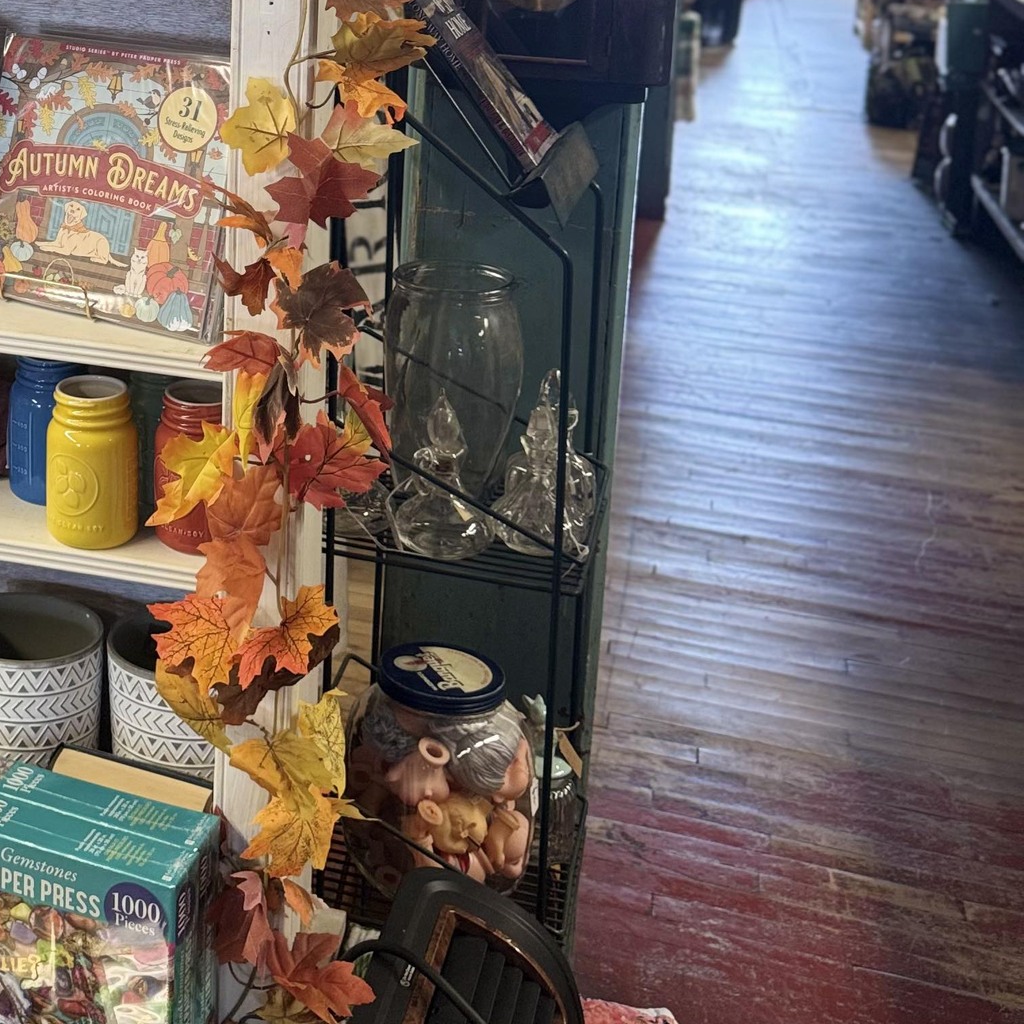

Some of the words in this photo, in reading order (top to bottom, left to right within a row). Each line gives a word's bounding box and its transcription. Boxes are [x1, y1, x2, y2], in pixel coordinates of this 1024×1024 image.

[444, 14, 472, 40] HOME
[178, 96, 203, 122] 31
[164, 116, 206, 139] Stress-Relieving
[172, 130, 194, 144] Designs
[4, 148, 100, 186] AUTUMN
[106, 152, 200, 214] DREAMS
[42, 183, 80, 194] ARTIST'S
[82, 187, 126, 204] COLORING
[128, 197, 152, 212] BOOK
[2, 766, 34, 792] 1000
[0, 843, 78, 882] Gemstones
[40, 879, 102, 918] PRESS
[110, 892, 161, 924] 1000
[114, 916, 155, 937] Pieces
